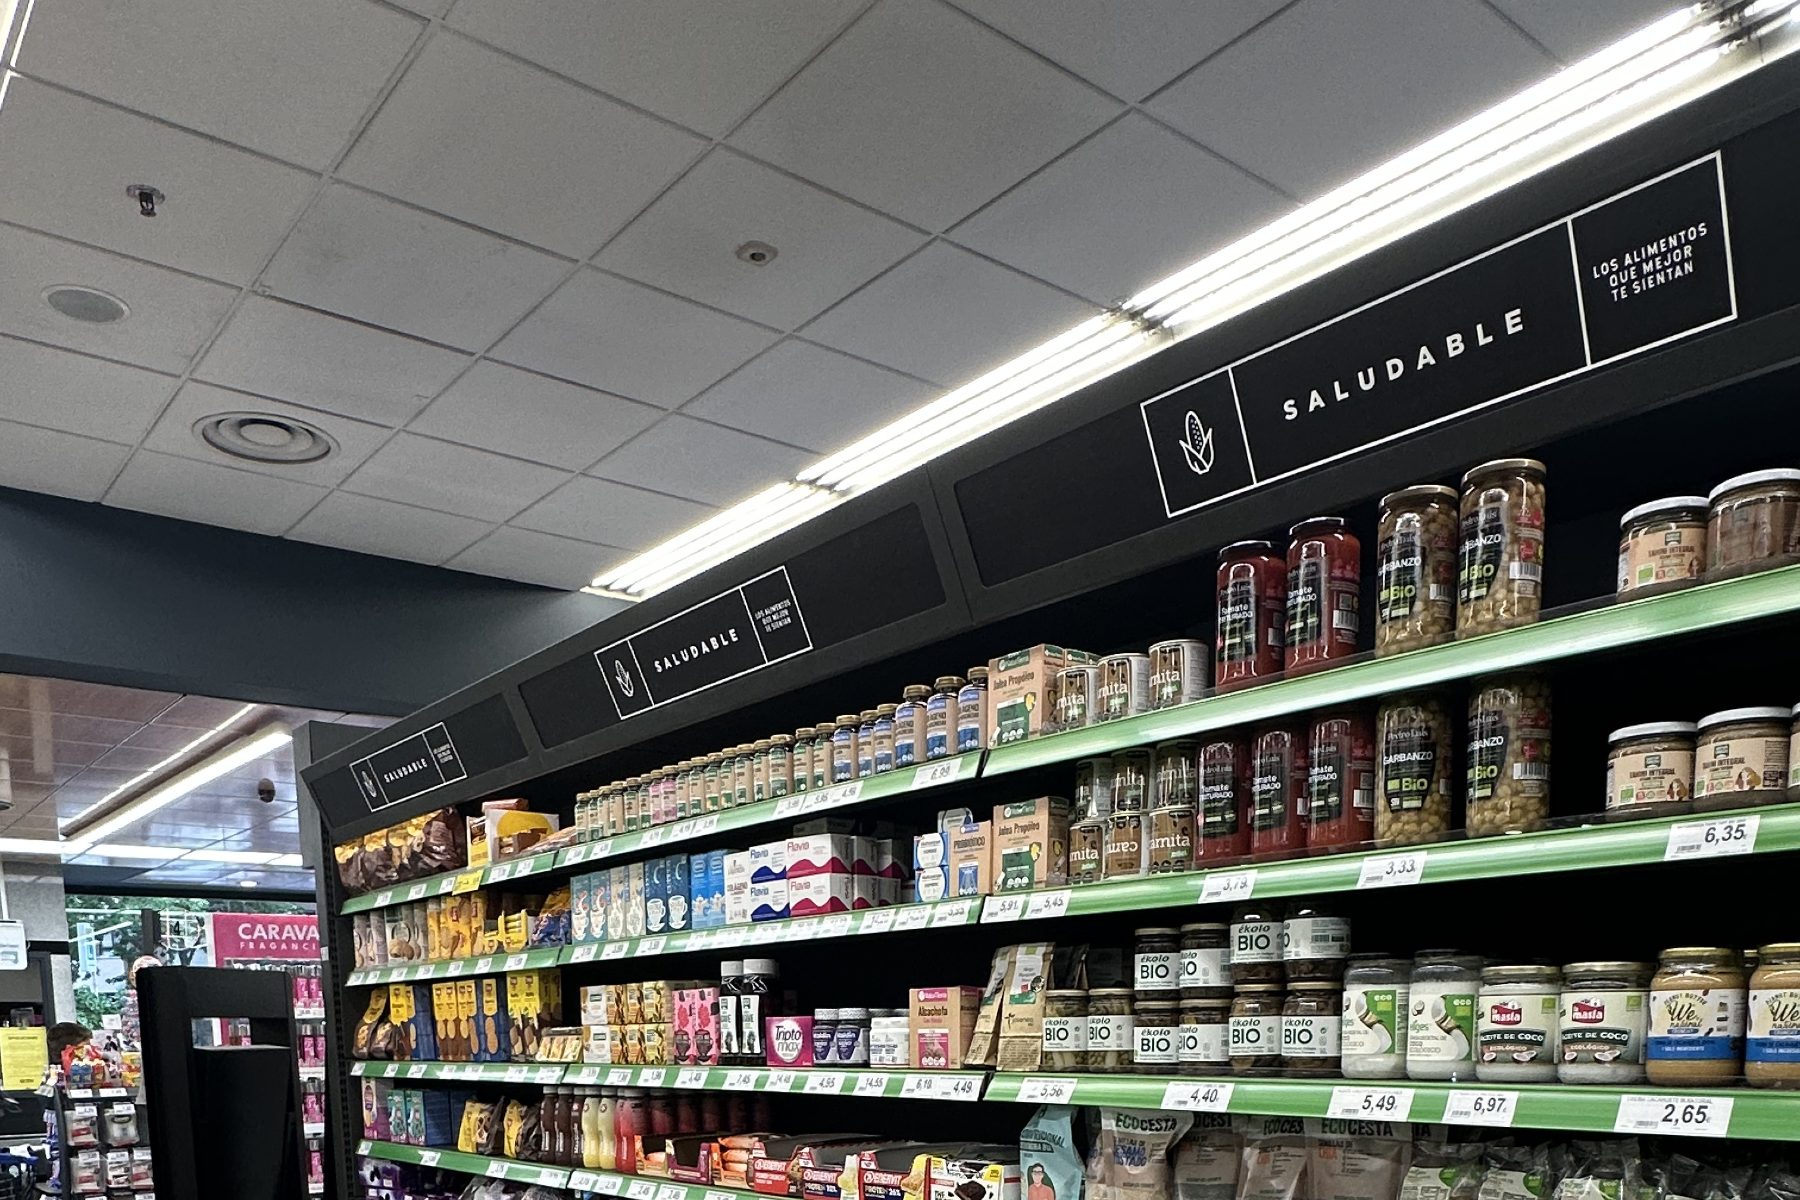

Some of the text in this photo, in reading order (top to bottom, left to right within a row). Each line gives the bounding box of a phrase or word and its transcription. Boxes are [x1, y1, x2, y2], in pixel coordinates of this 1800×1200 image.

[1593, 222, 1708, 278] LOS ALIMENTOS
[1610, 245, 1692, 286] QUE MEJOR
[1612, 261, 1693, 302] TE SIENTAN
[1283, 308, 1525, 421] SALUDABLE
[654, 628, 738, 672] SALUDABLE
[1402, 778, 1428, 790] BiO
[1704, 823, 1745, 846] 6,35
[238, 923, 320, 940] CARAVA
[1239, 924, 1270, 933] ékolo
[1238, 935, 1270, 950] BIO
[1141, 954, 1169, 963] ékolo
[1141, 964, 1169, 979] BIO
[1666, 1000, 1695, 1021] We
[1045, 1027, 1069, 1041] BIO
[1089, 1026, 1111, 1040] BIO
[1141, 1028, 1170, 1037] ékolo
[1232, 1028, 1261, 1044] BIO
[1284, 1029, 1313, 1044] BIO
[1517, 1032, 1544, 1041] COCO
[1600, 1032, 1628, 1041] COCO
[1141, 1038, 1170, 1052] BIO
[1190, 1088, 1217, 1103] 4,40
[1362, 1094, 1396, 1113] 5,49
[1473, 1097, 1505, 1115] 6,97
[1661, 1103, 1708, 1126] 2,65
[1264, 1119, 1304, 1135] ECOCES
[1322, 1121, 1393, 1137] ECOCESTA
